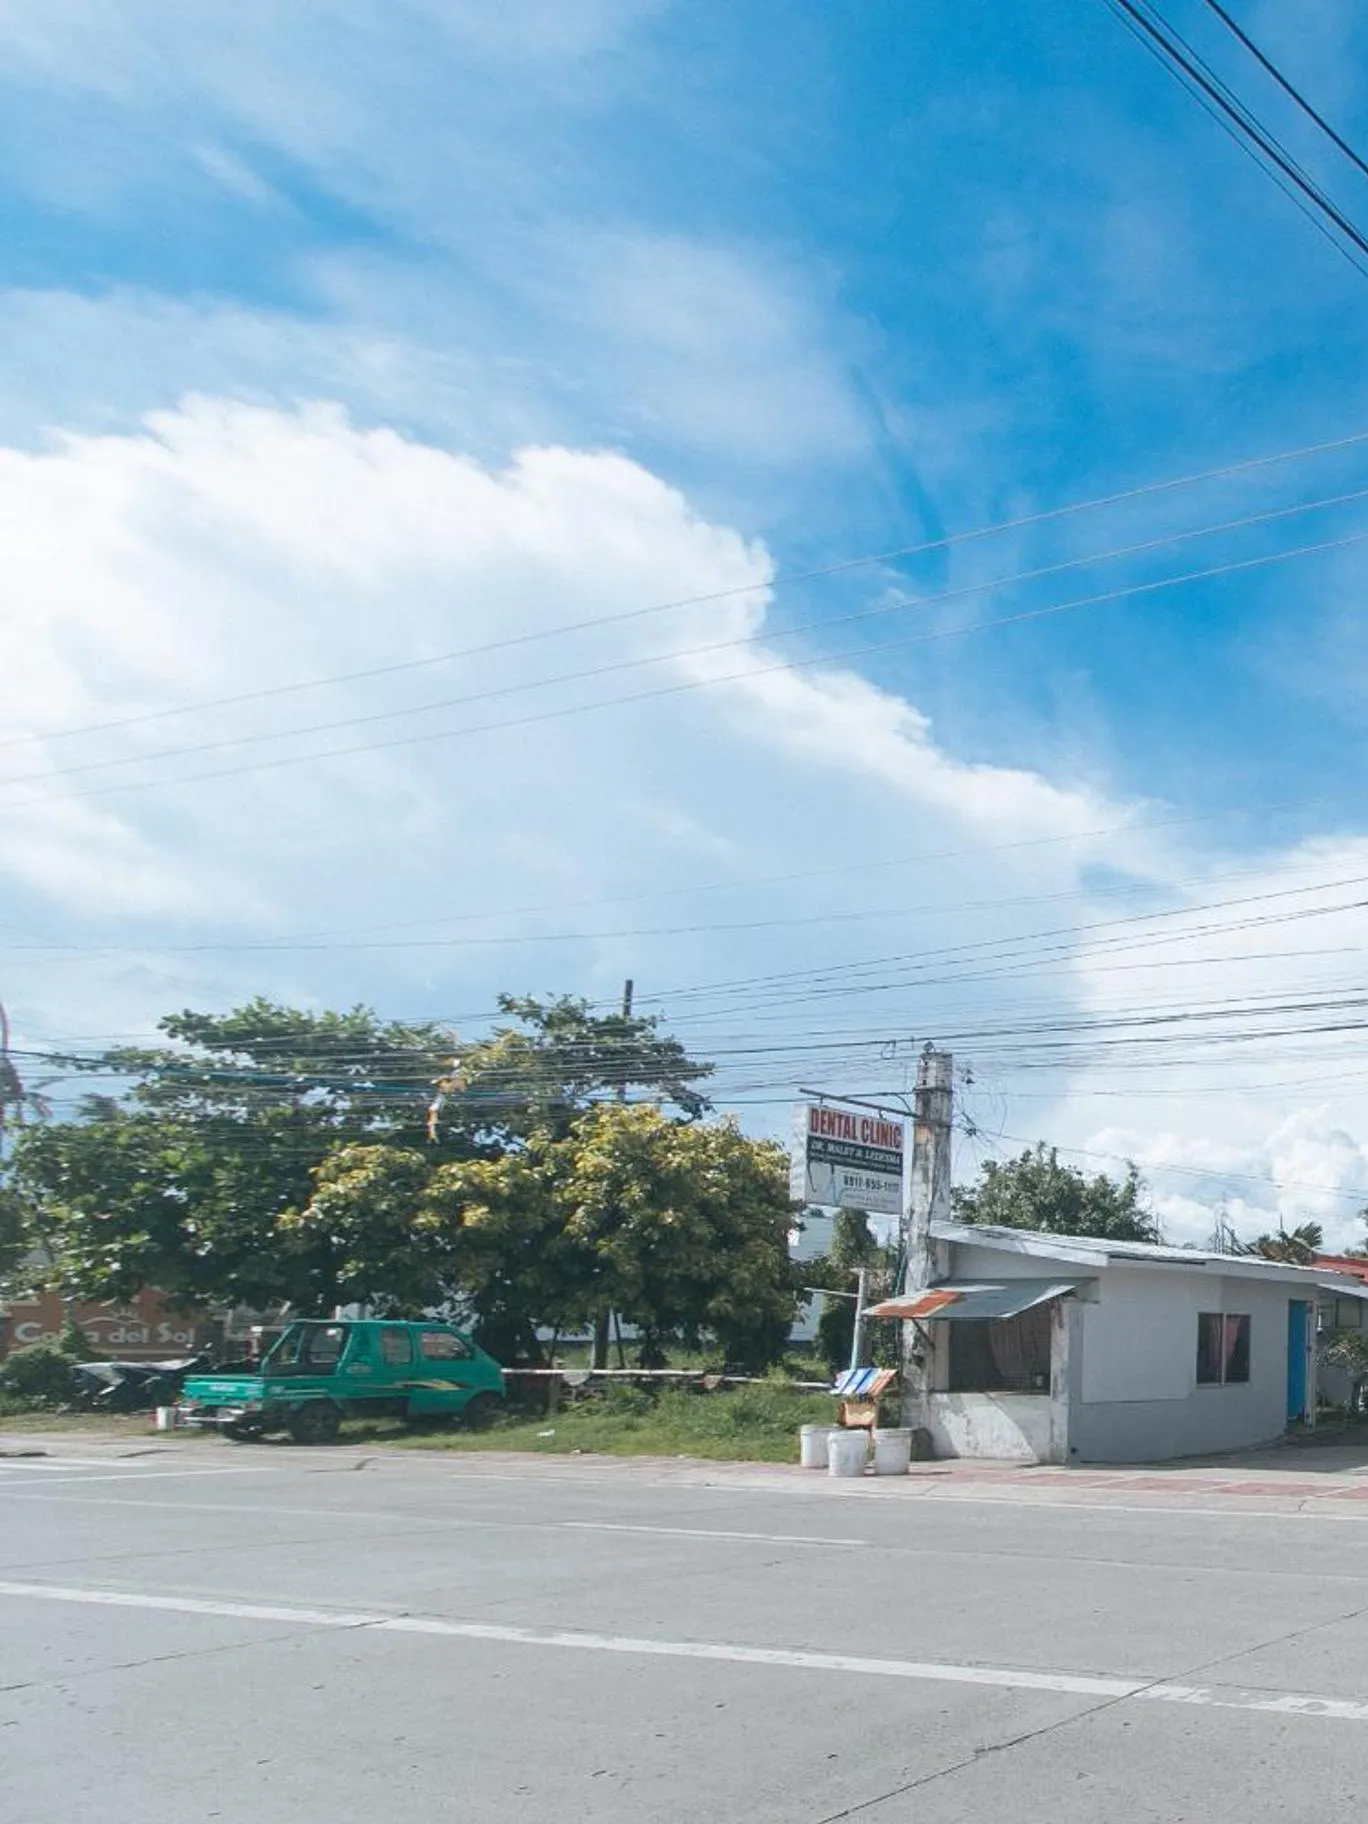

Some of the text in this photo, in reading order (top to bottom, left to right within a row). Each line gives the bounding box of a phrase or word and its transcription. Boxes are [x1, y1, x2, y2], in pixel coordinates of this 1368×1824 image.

[811, 1107, 902, 1149] DENTAL CLINIC
[108, 1327, 150, 1344] del
[157, 1321, 197, 1344] Sol
